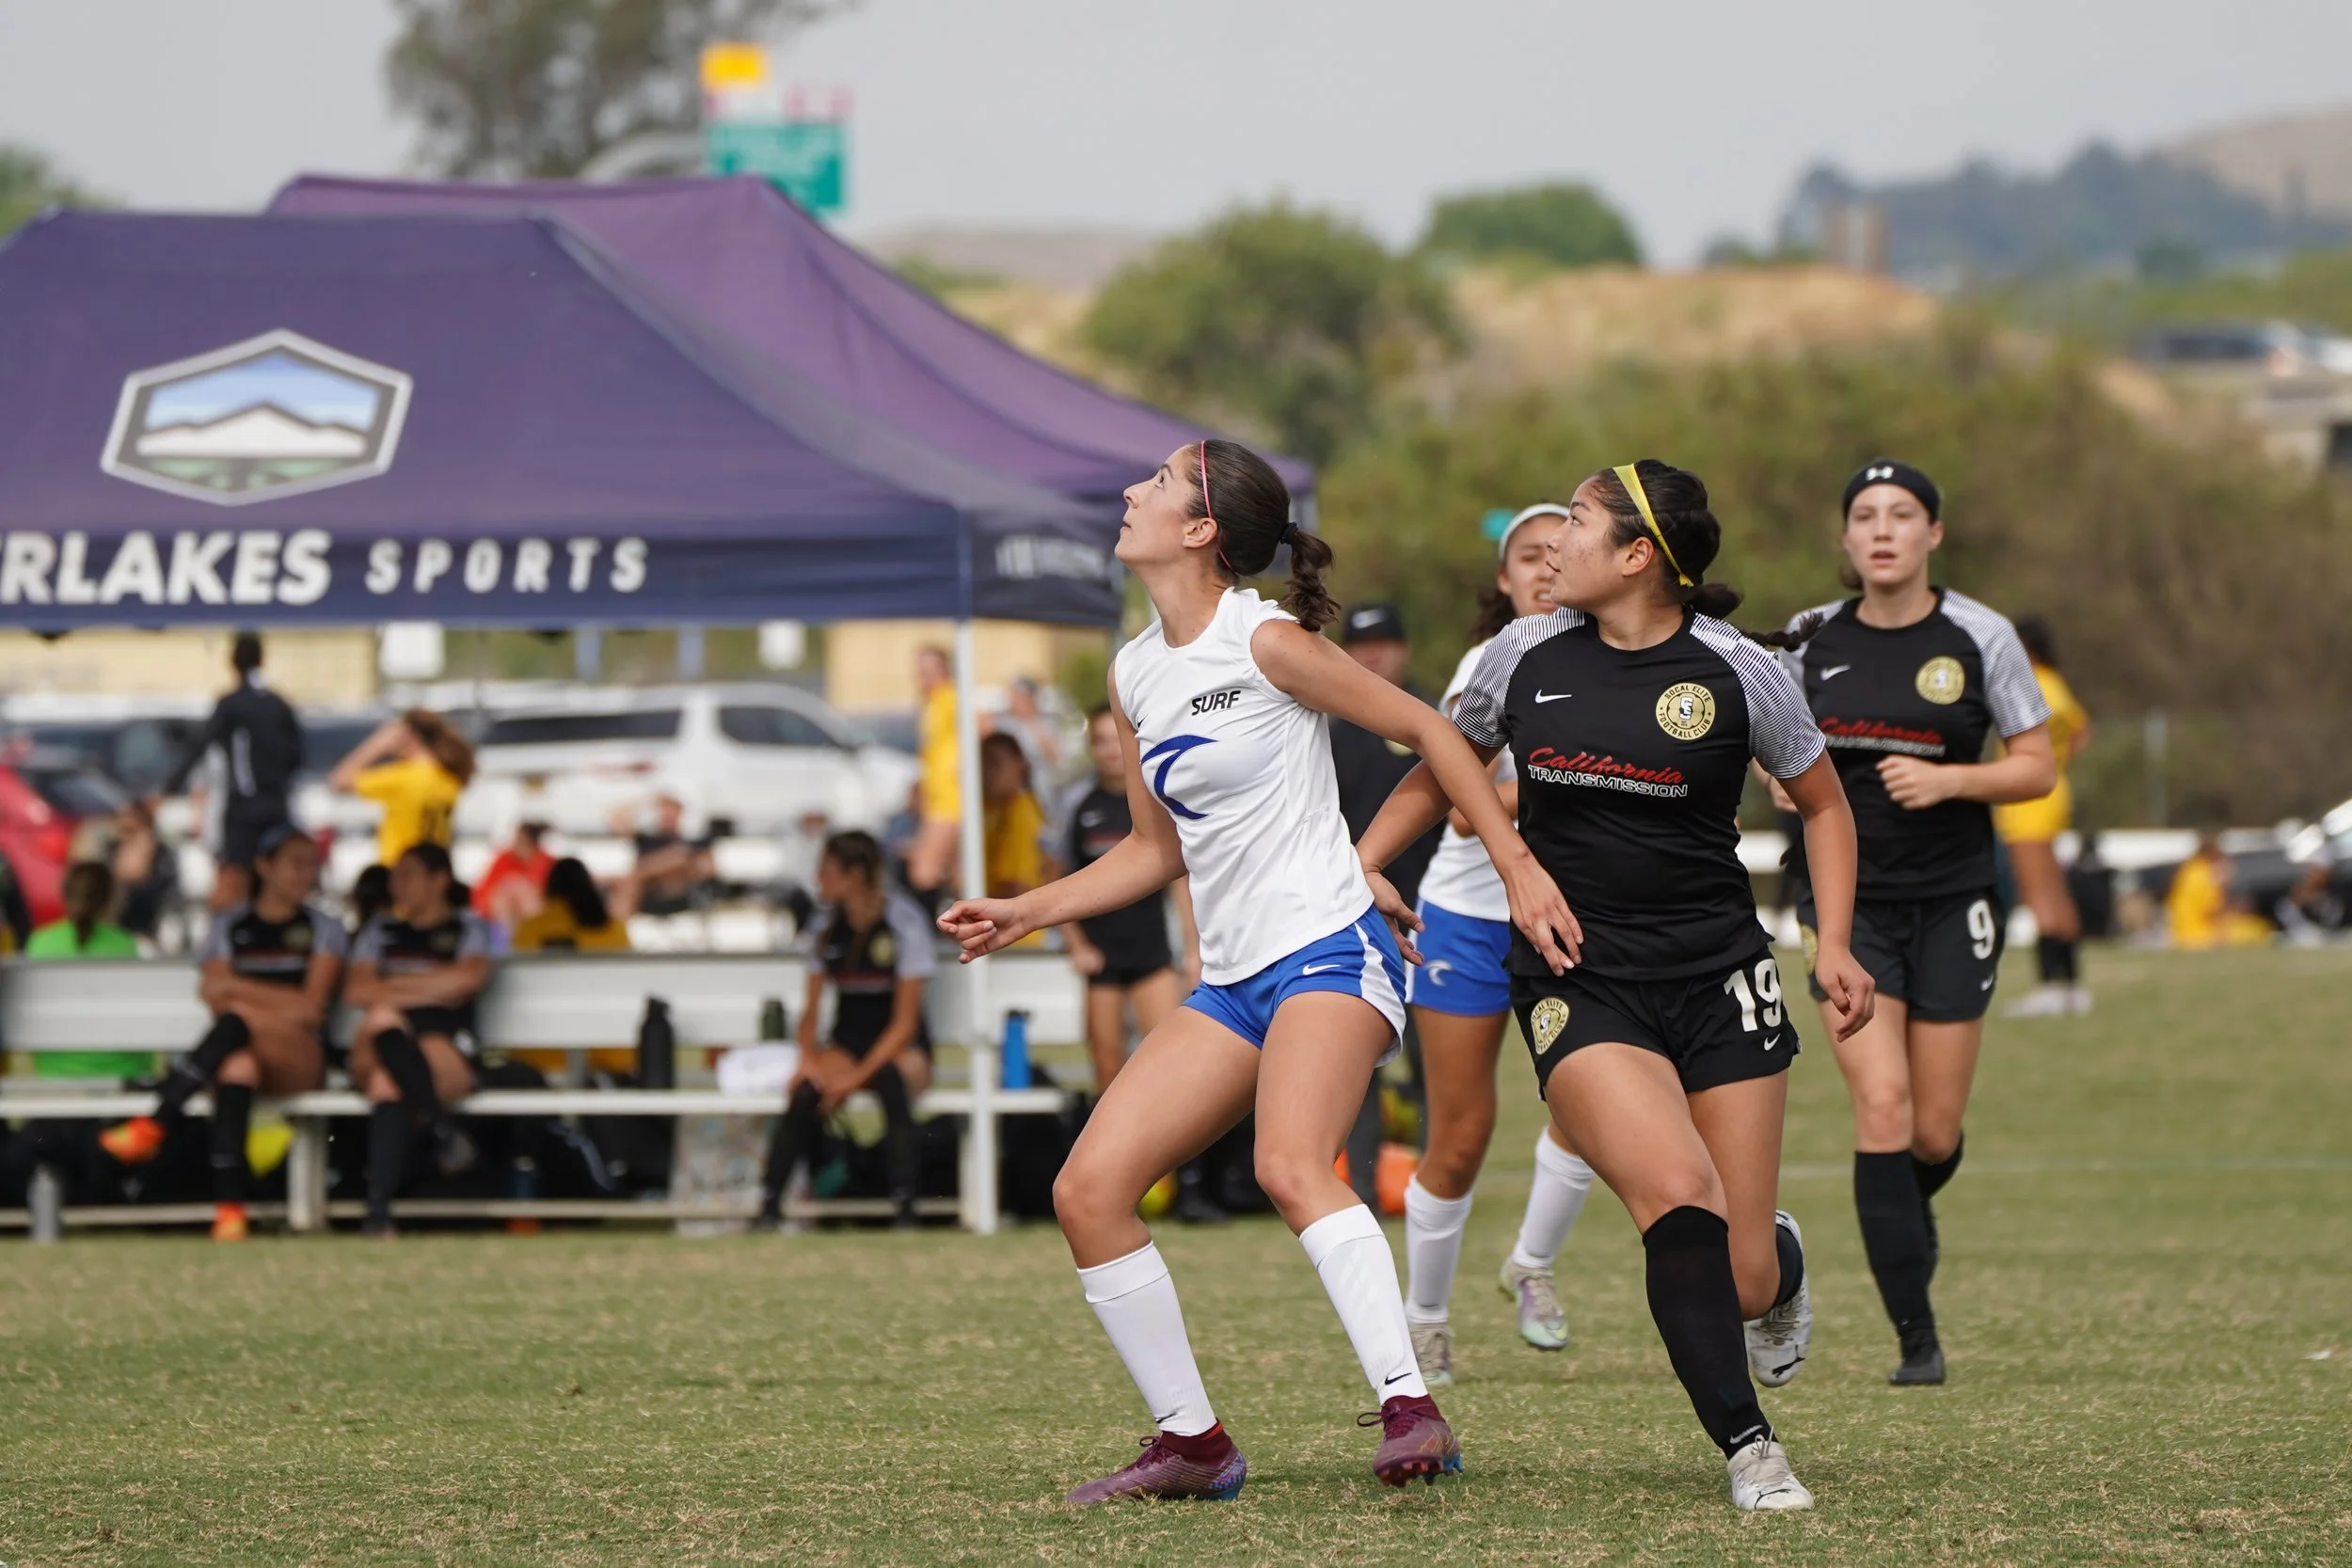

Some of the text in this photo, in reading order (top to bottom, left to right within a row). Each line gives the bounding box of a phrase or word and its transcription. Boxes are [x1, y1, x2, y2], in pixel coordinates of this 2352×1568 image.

[0, 531, 649, 605] RLAKES SPORTS
[1191, 689, 1241, 716] SURF
[1665, 685, 1711, 703] SOCAL ELITE
[1659, 713, 1710, 737] FOOTBALL CLUB
[1528, 764, 1688, 798] TRANSMISSION
[1529, 747, 1685, 784] California
[1966, 899, 1994, 959] 9
[1724, 958, 1782, 1032] 19
